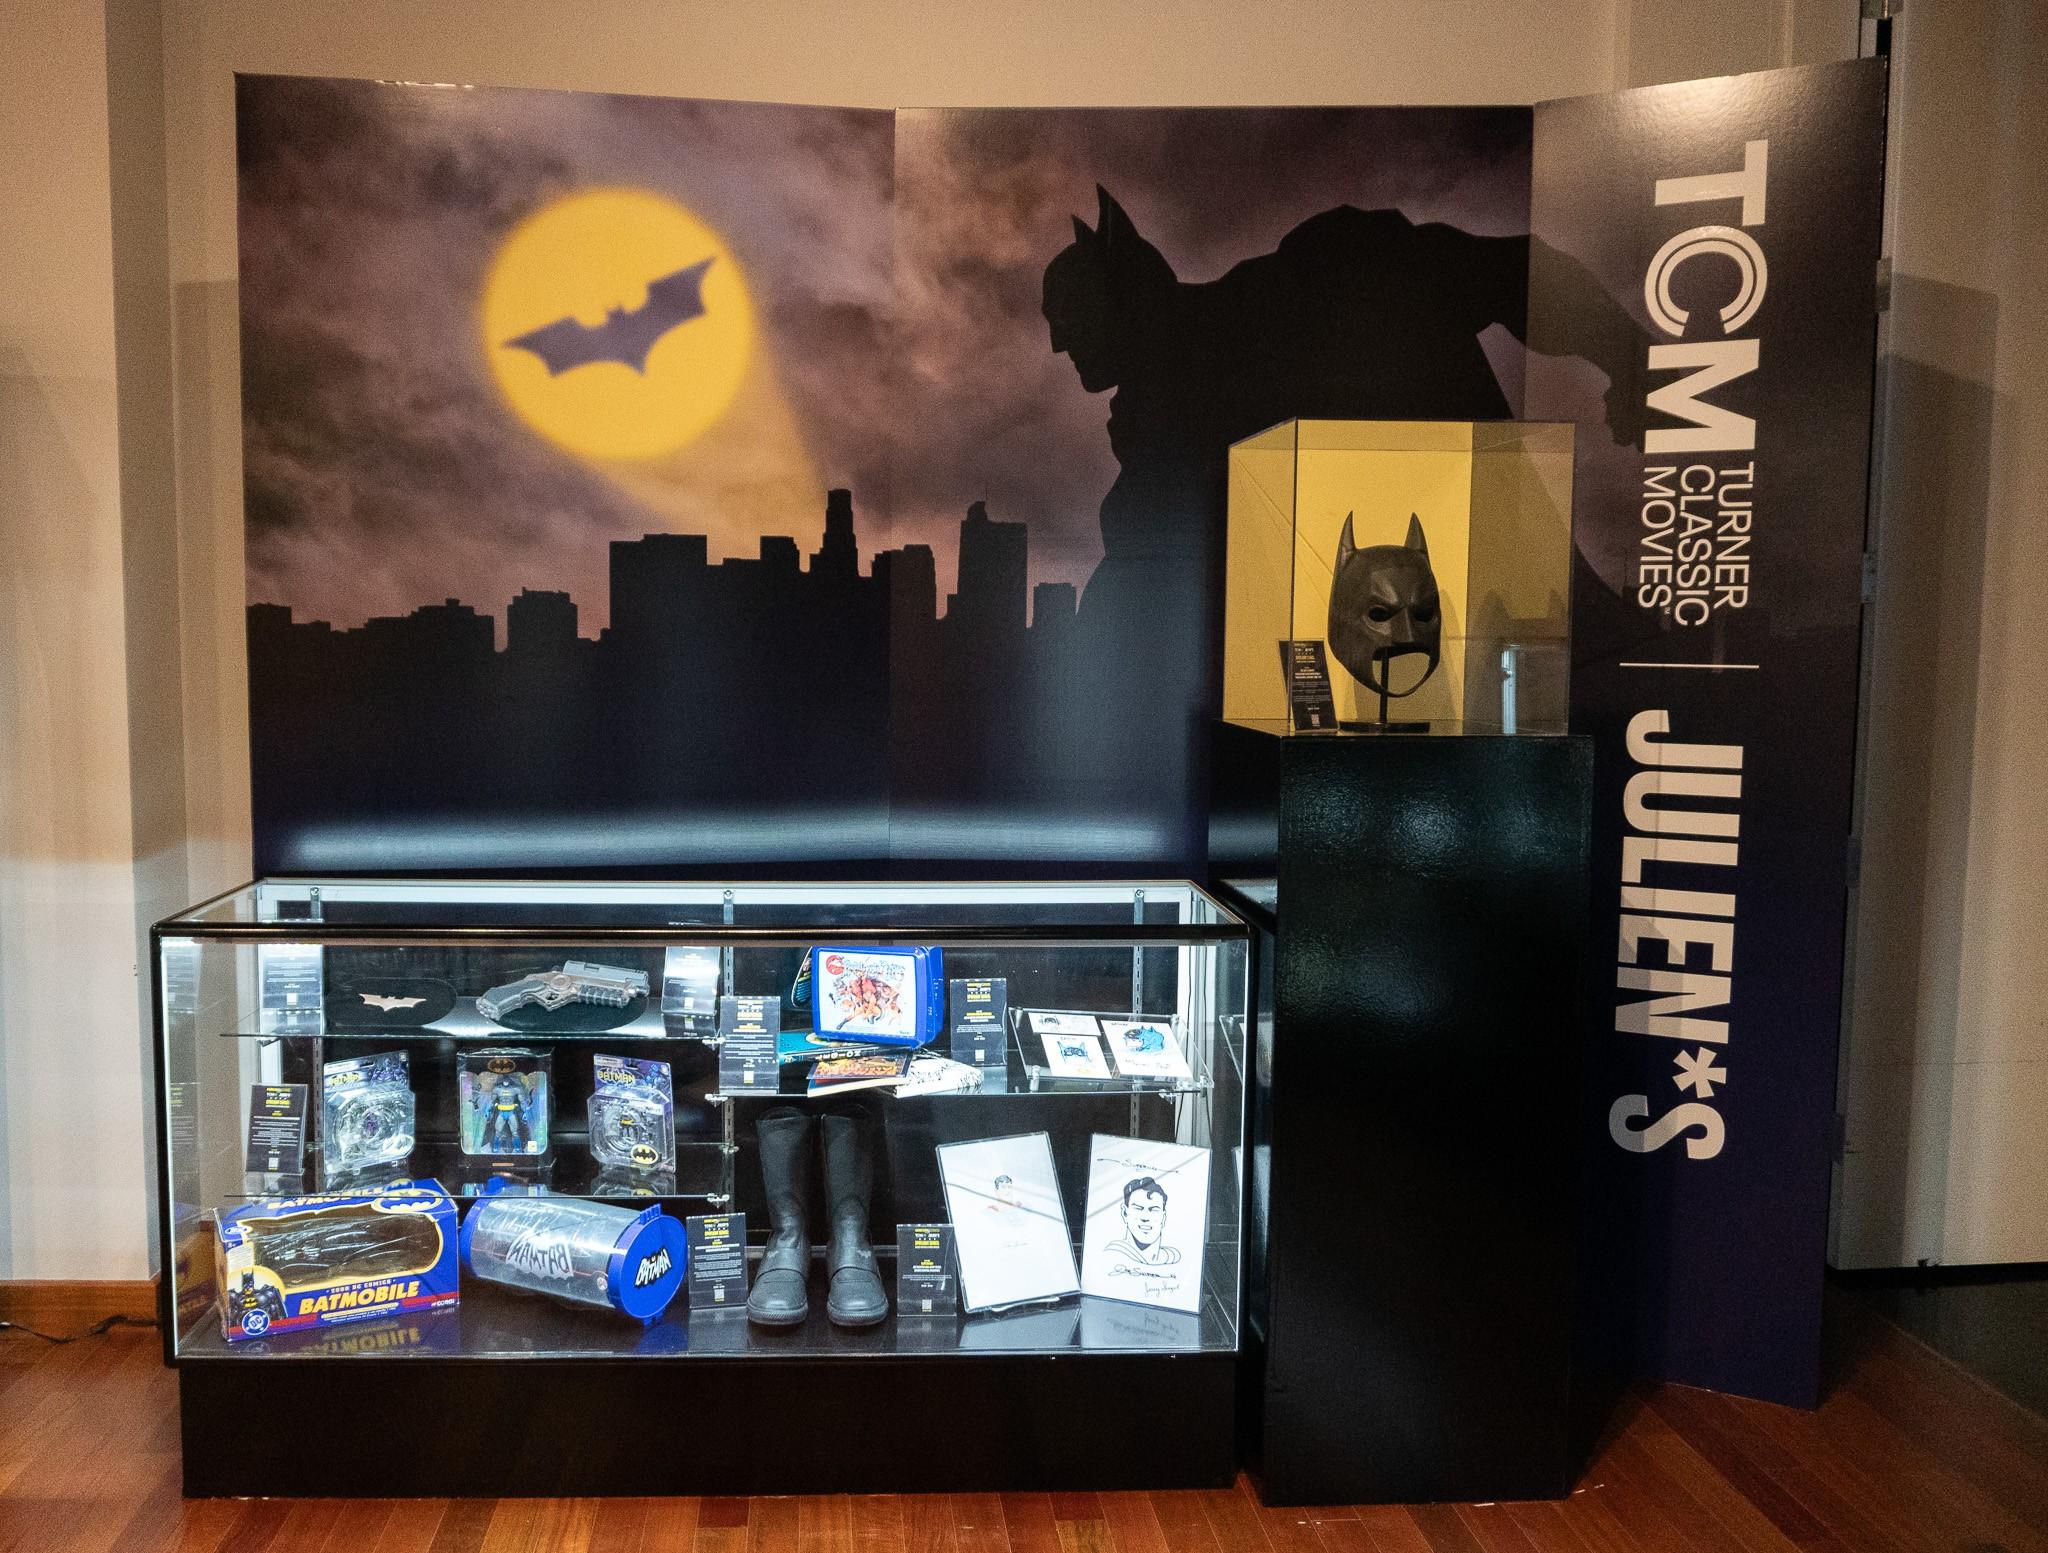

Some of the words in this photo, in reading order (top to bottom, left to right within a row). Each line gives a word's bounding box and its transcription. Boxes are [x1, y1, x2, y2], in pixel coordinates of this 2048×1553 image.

[1644, 138, 1768, 454] TCM
[1637, 465, 1677, 610] MOVIES
[1674, 463, 1716, 627] CLASSIC
[1712, 460, 1756, 609] TURNER
[298, 1280, 421, 1315] BATMOBILE
[634, 1248, 672, 1286] BATMAN
